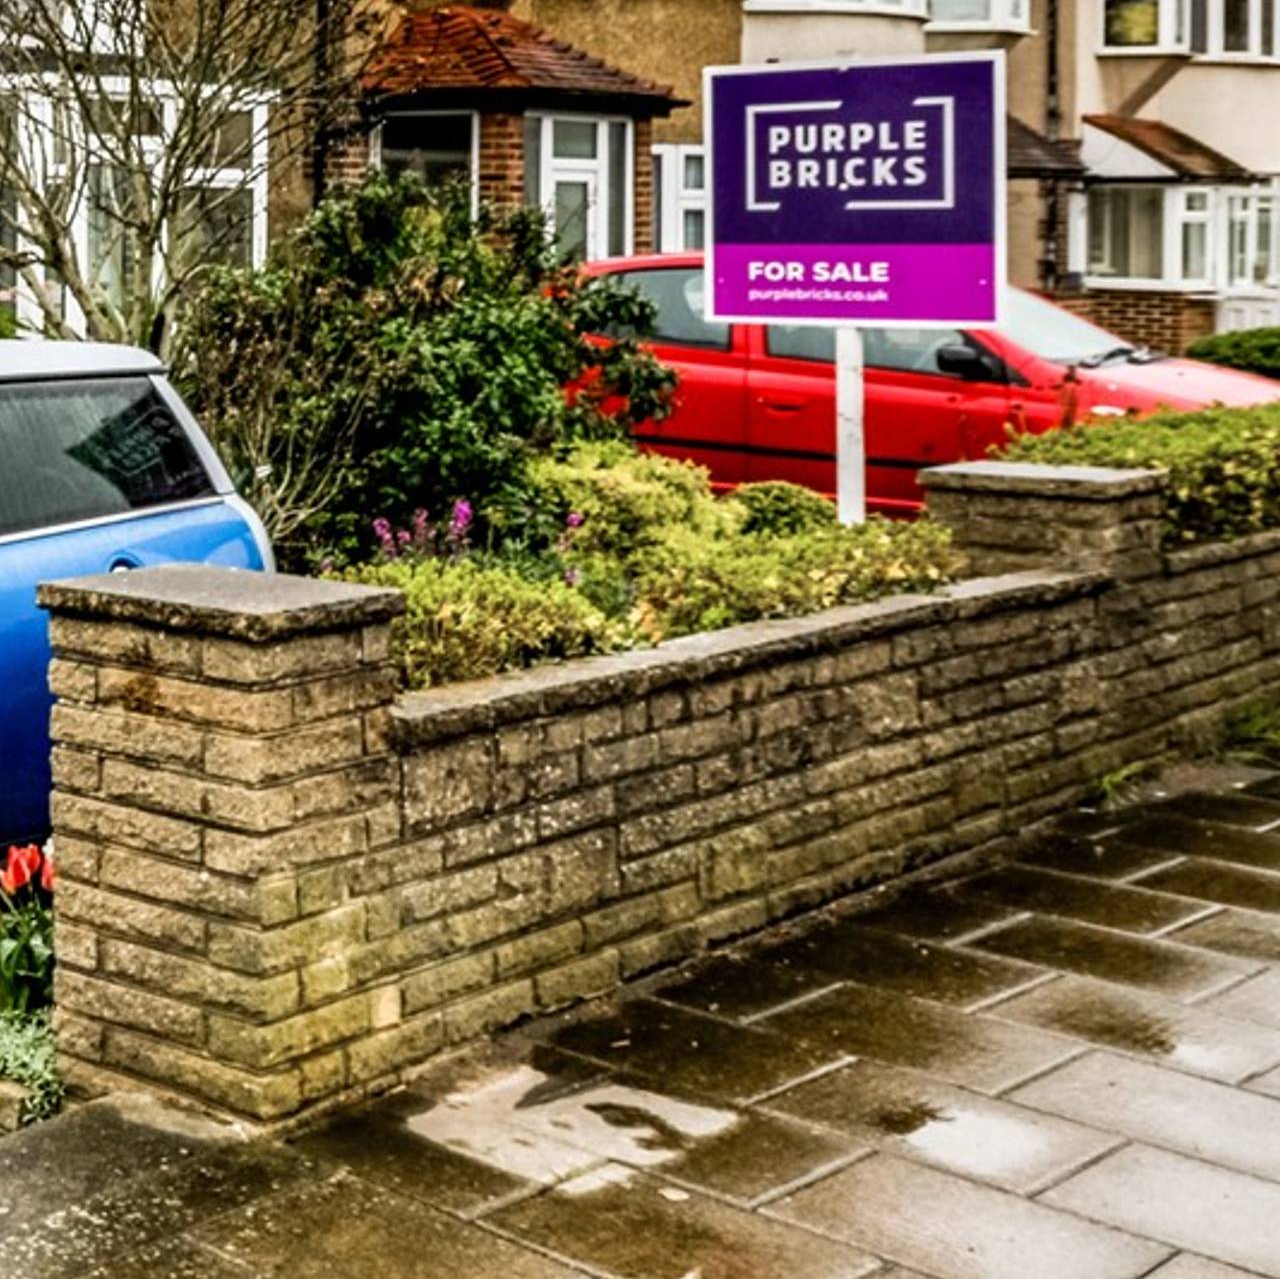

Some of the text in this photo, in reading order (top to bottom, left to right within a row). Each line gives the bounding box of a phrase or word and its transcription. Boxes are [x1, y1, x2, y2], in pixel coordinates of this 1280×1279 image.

[769, 121, 927, 154] PURPLE
[769, 156, 927, 189] BRICKS
[748, 261, 890, 283] FOR SALE
[748, 288, 889, 302] purplebricks.co.uk
